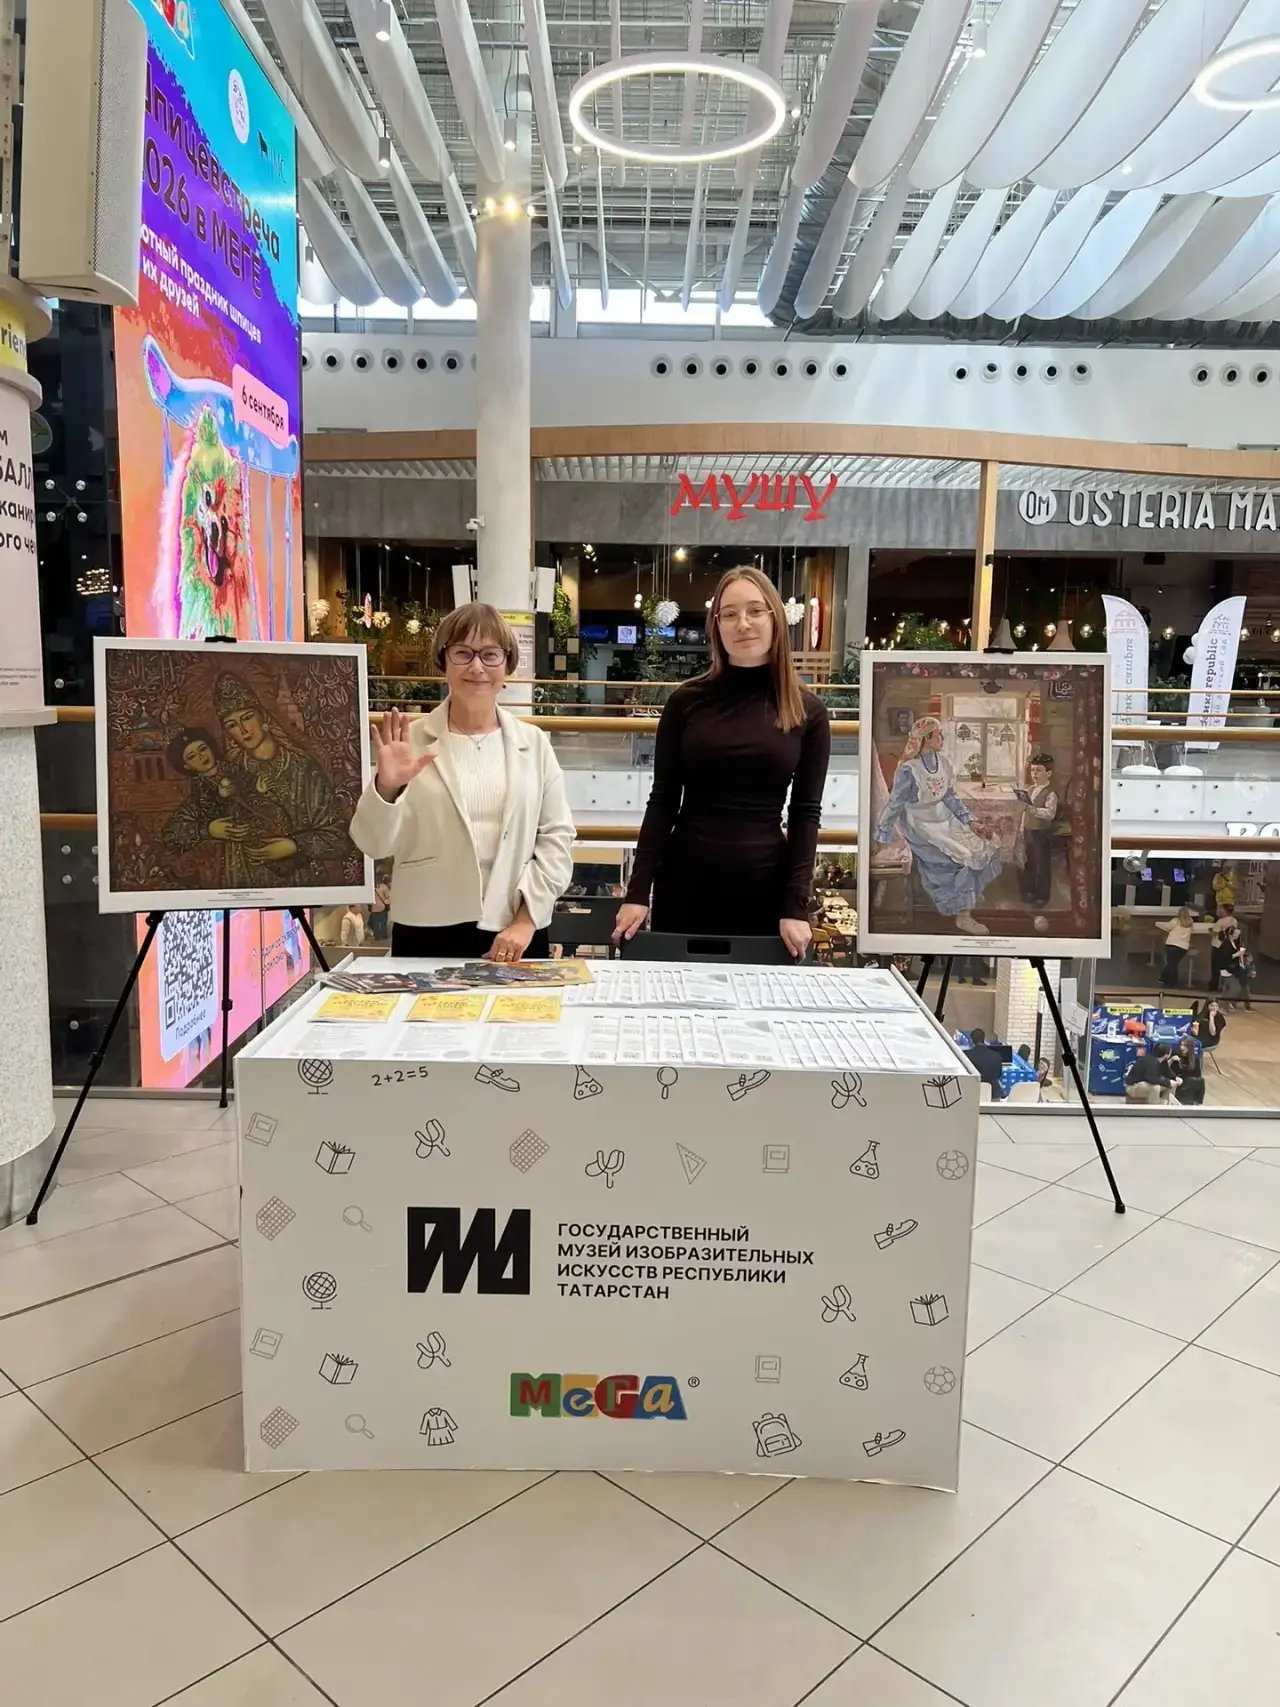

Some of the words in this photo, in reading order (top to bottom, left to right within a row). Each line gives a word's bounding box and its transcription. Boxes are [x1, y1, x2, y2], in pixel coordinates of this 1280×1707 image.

[141, 137, 191, 226] 026
[196, 204, 206, 243] в
[142, 255, 158, 284] их
[160, 270, 200, 318] друзей
[180, 258, 229, 314] праздник
[229, 303, 262, 345] шпицев
[242, 385, 247, 405] 6
[249, 395, 284, 432] сентября
[670, 472, 838, 521] МУШУ
[1068, 488, 1216, 530] OSTERIA
[1227, 491, 1277, 531] MA
[1205, 637, 1218, 688] republic
[371, 1065, 429, 1087] 2+2=5
[557, 1222, 750, 1243] ГОСУДАРСТВЕННЫЙ
[557, 1241, 621, 1259] МУЗЕЙ
[625, 1244, 815, 1265] ИЗОБРАЗИТЕЛЬНЫХ
[557, 1263, 658, 1280] ИСКУССТВ
[663, 1266, 787, 1284] РЕСПУБЛИКИ
[557, 1283, 670, 1299] ТАТАРСТАН
